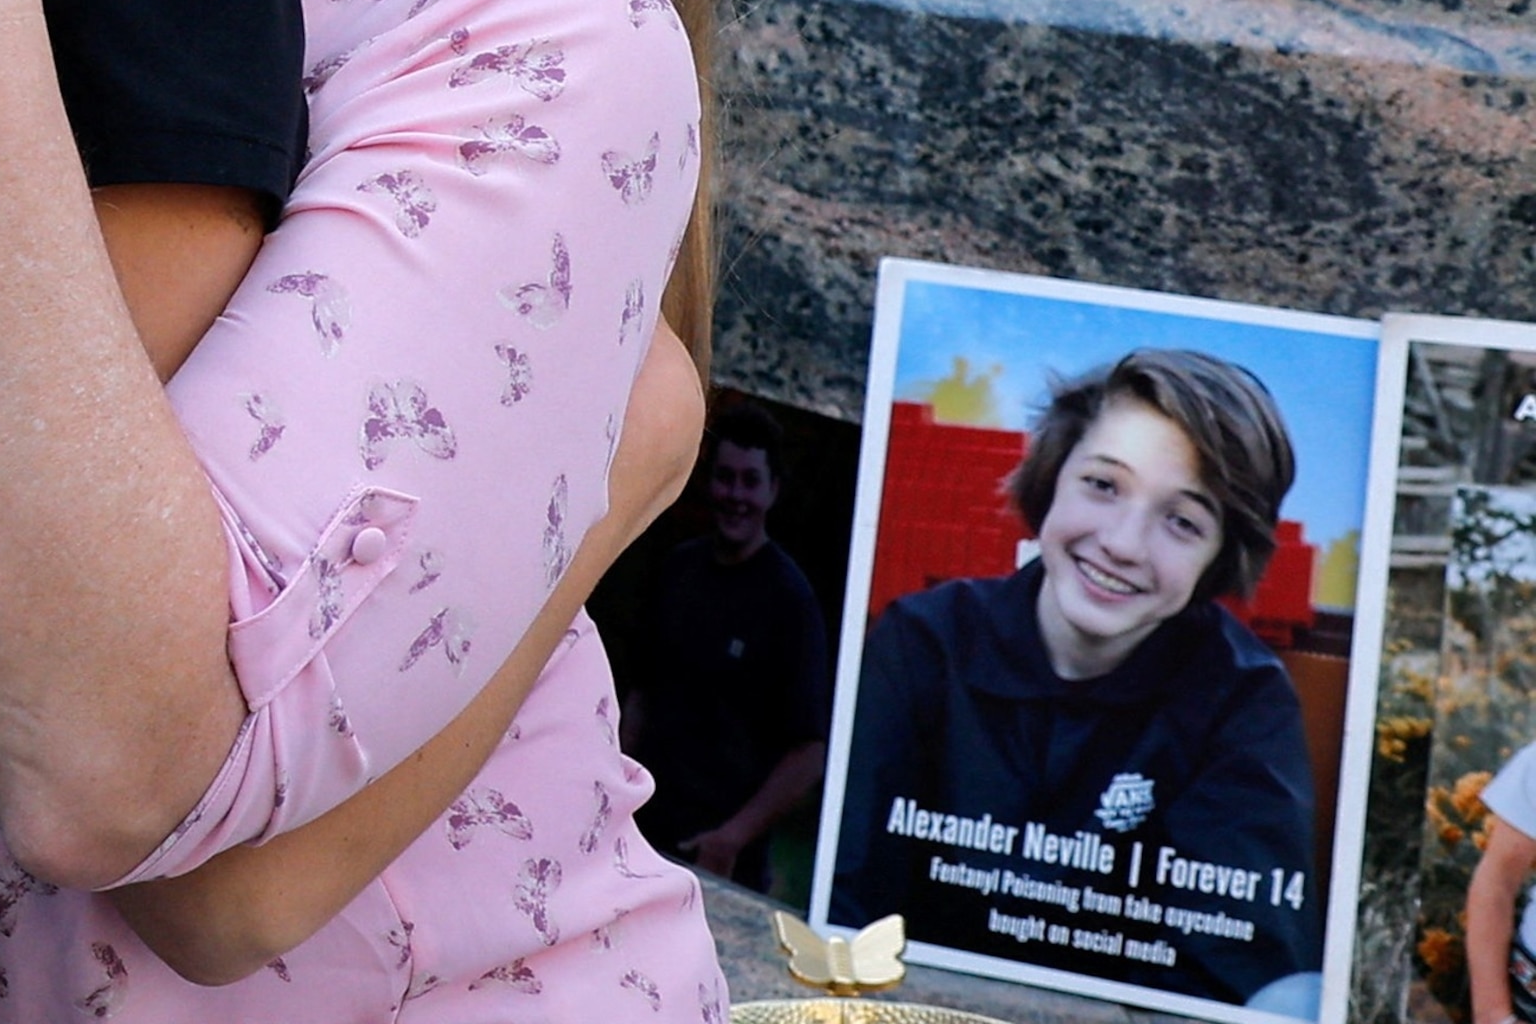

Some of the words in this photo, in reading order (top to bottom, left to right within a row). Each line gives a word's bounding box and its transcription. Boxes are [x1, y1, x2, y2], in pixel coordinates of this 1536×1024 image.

[887, 796, 1019, 855] Alexander
[1022, 821, 1115, 874] Neville
[1156, 846, 1262, 902] Forever
[1270, 868, 1305, 910] 14
[930, 856, 1000, 896] Fentanyl
[1001, 870, 1081, 913] Poisoning
[1082, 886, 1122, 916] from
[1124, 893, 1163, 924] fake
[1165, 906, 1255, 942] oxycodone
[989, 908, 1046, 942] bought
[1048, 924, 1070, 945] on
[1072, 929, 1123, 956] social
[1124, 938, 1177, 967] media
